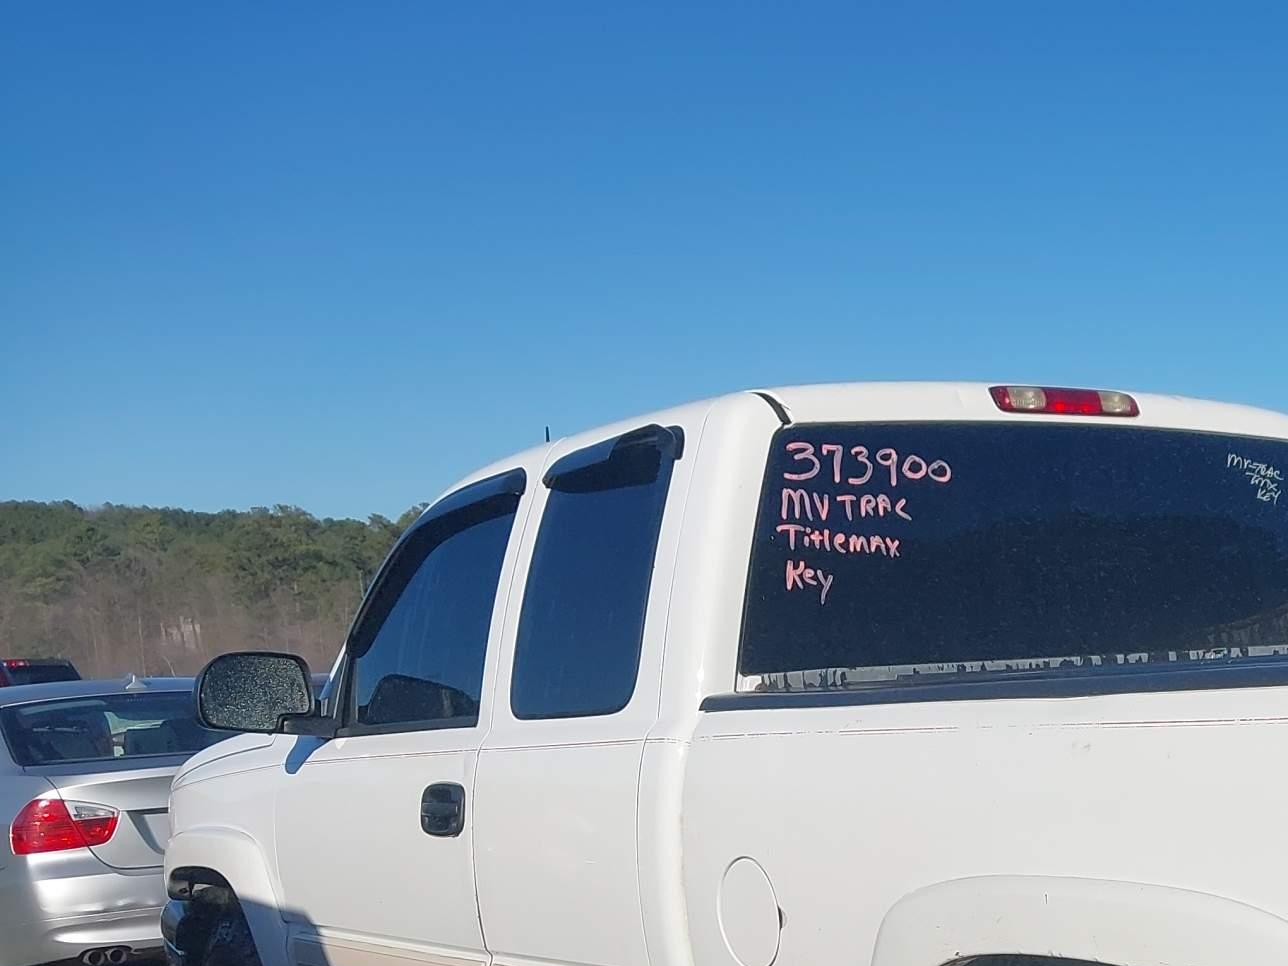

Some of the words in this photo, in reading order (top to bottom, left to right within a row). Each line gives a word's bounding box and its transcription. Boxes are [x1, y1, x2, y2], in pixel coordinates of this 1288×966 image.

[783, 441, 952, 487] 373900
[781, 488, 829, 521] MV
[785, 559, 834, 605] Key
